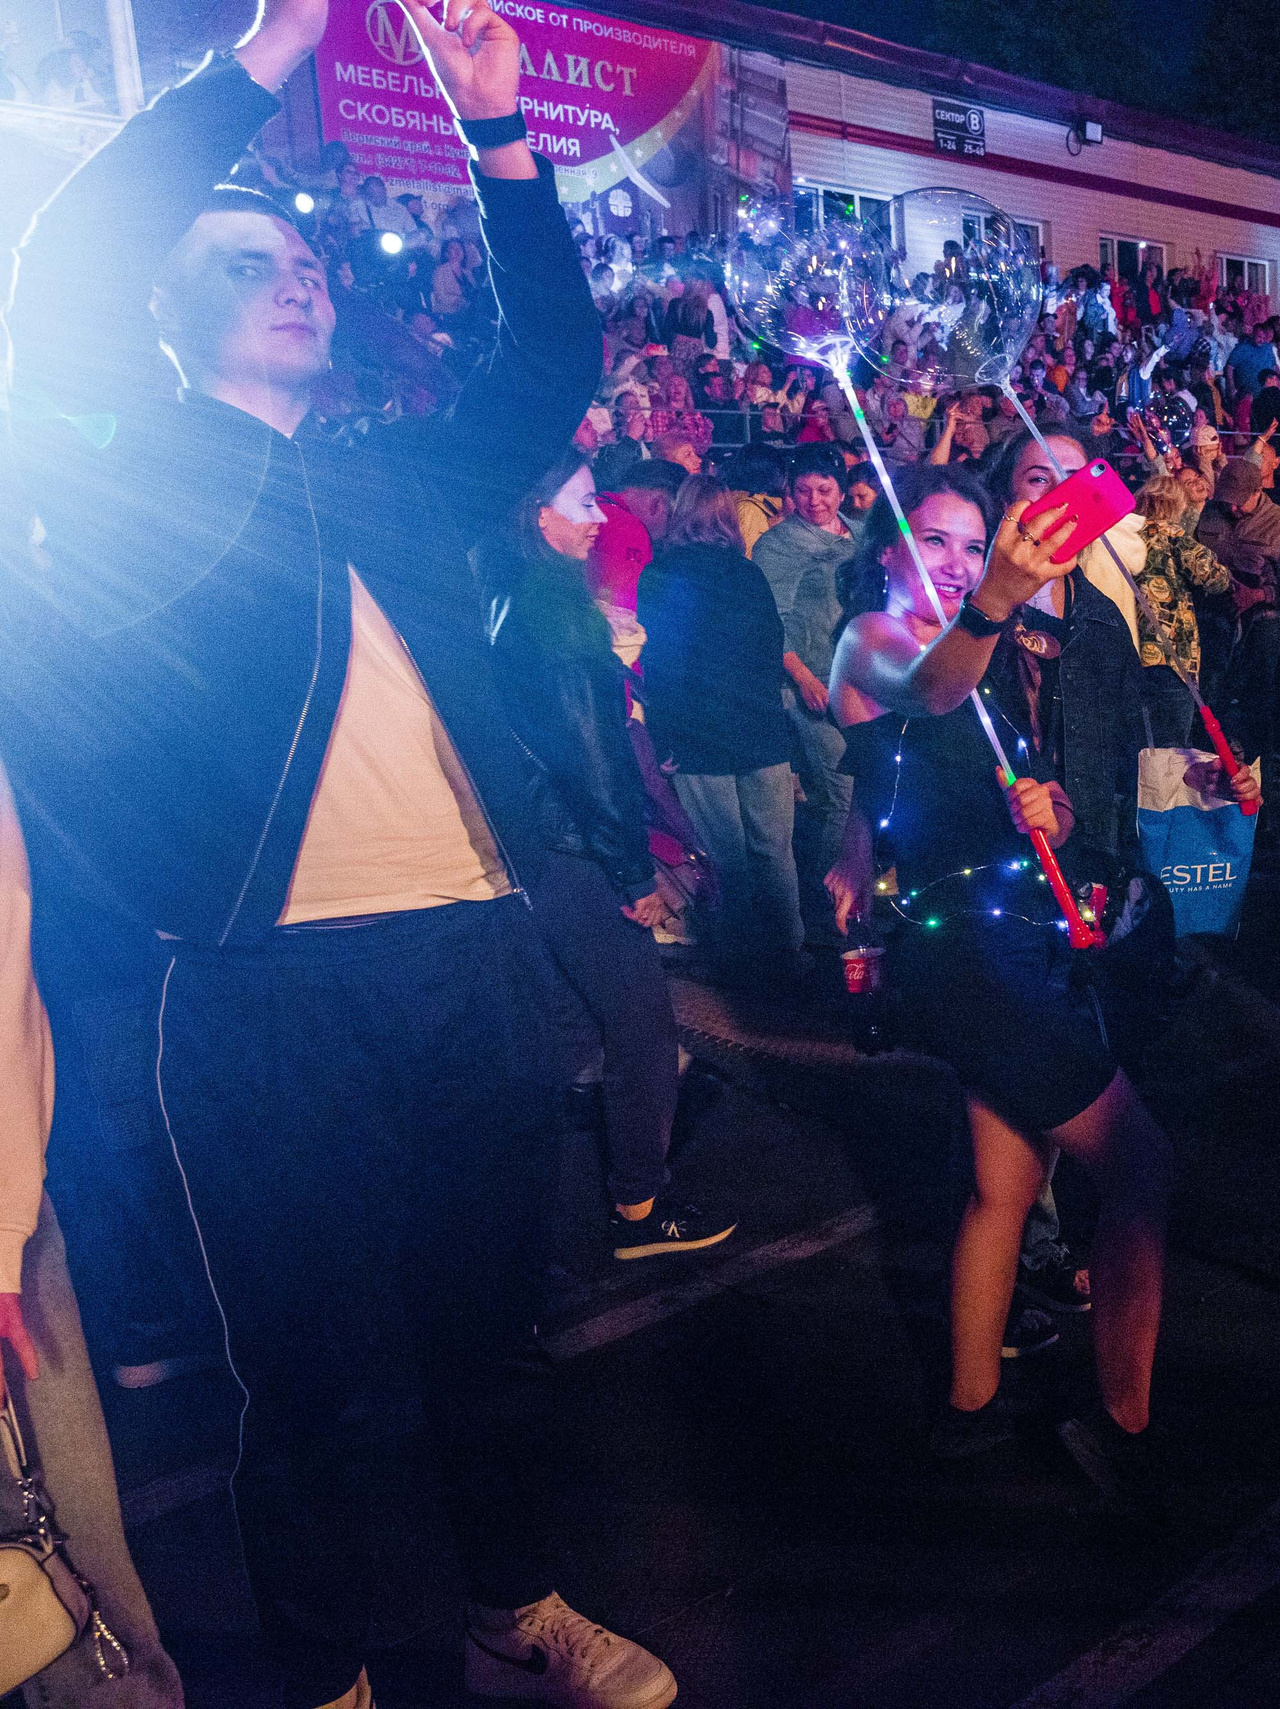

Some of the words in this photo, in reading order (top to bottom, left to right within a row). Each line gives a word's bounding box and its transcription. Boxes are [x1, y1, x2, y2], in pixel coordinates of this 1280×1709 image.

[549, 12, 568, 28] ОТ
[573, 18, 696, 57] ПРОИЗВОДИТЕЛЯ
[516, 96, 620, 135] РНИТУРА,
[935, 109, 965, 124] СЕКТОР
[527, 131, 581, 157] ЕЛИЯ
[939, 140, 957, 151] 1-24
[1160, 862, 1237, 885] ESTEL
[1187, 885, 1203, 893] HAS
[1212, 882, 1233, 890] NAME
